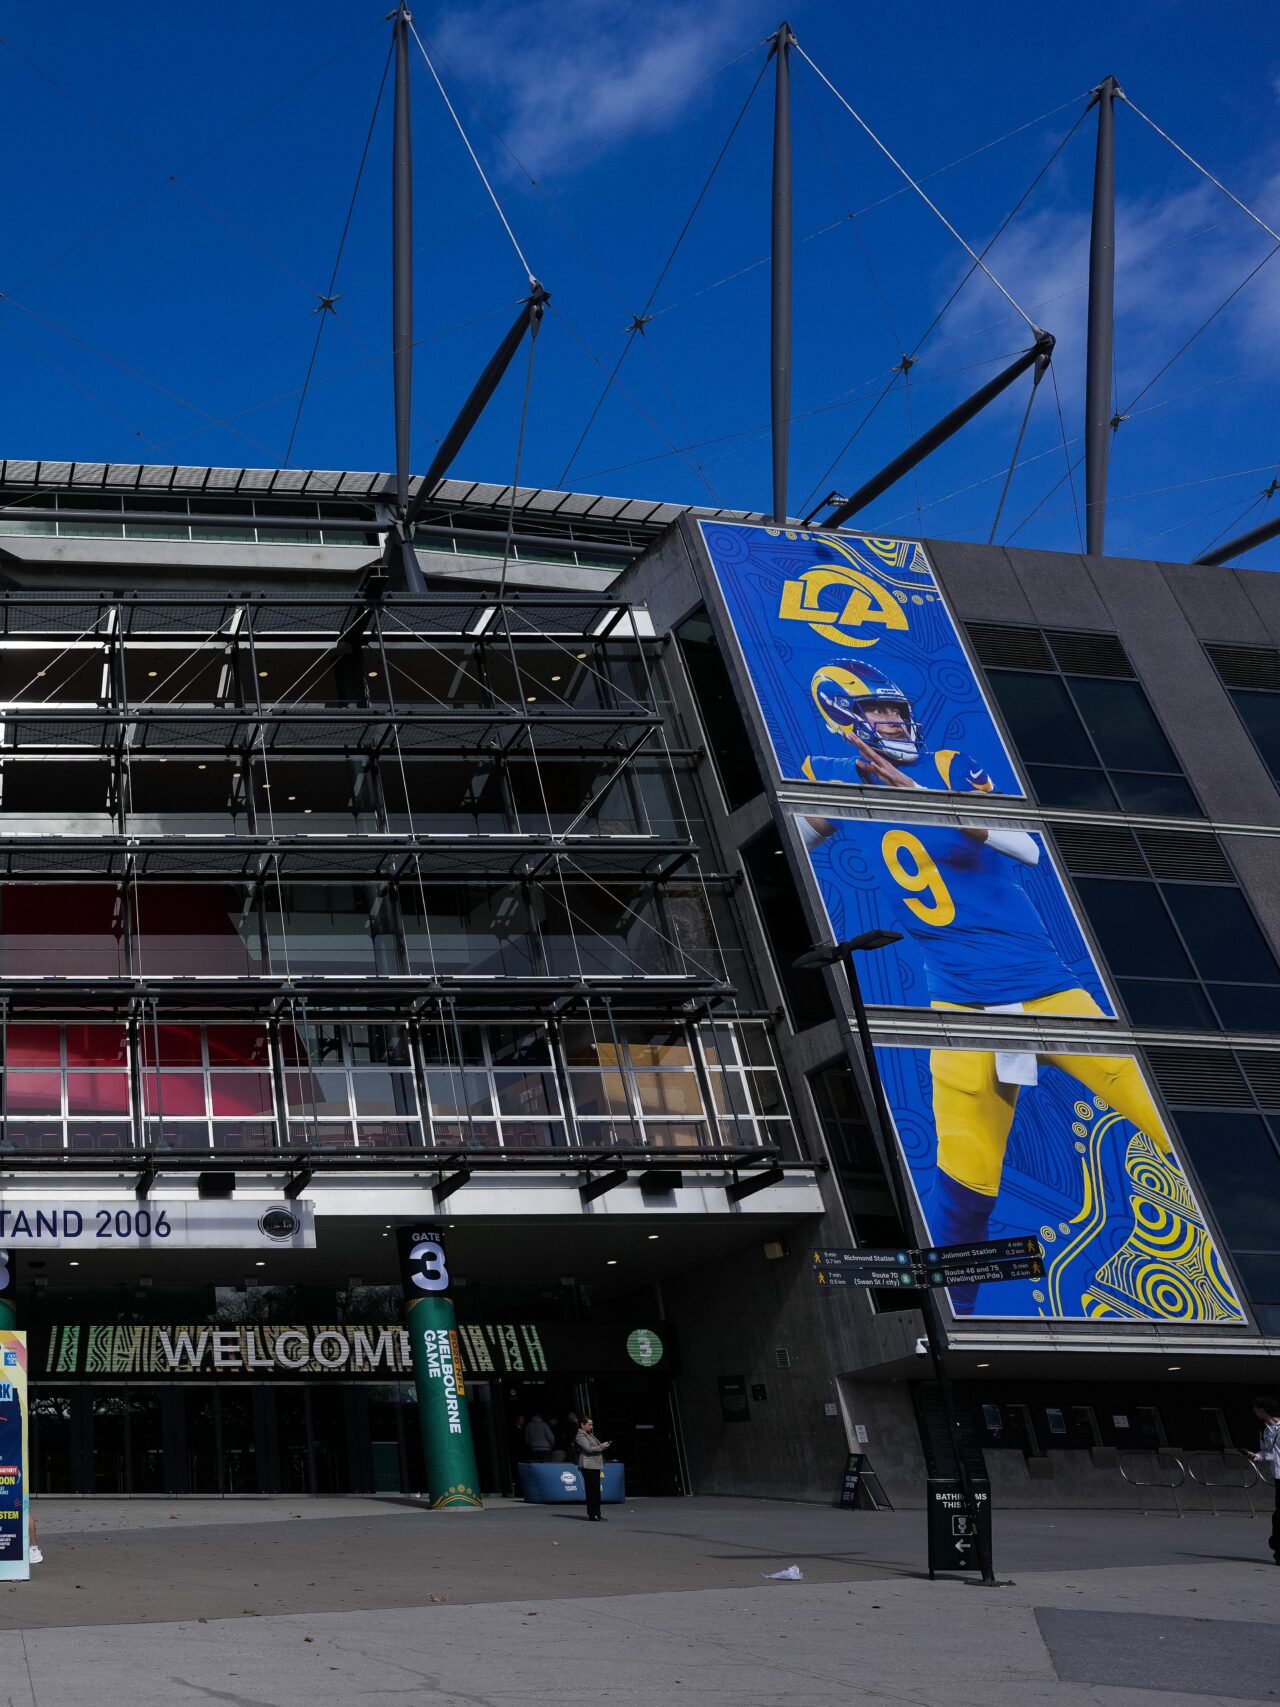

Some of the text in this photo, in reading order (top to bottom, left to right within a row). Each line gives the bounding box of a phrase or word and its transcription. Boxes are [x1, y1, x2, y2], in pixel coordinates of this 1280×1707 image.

[882, 830, 956, 926] 9
[95, 1210, 172, 1238] 2006
[412, 1232, 440, 1242] GATE
[410, 1242, 449, 1290] 3
[942, 1248, 997, 1260] Jolimont Station
[946, 1274, 985, 1284] (Wellington
[424, 1330, 441, 1378] GAME
[436, 1330, 462, 1434] MELBOURNE
